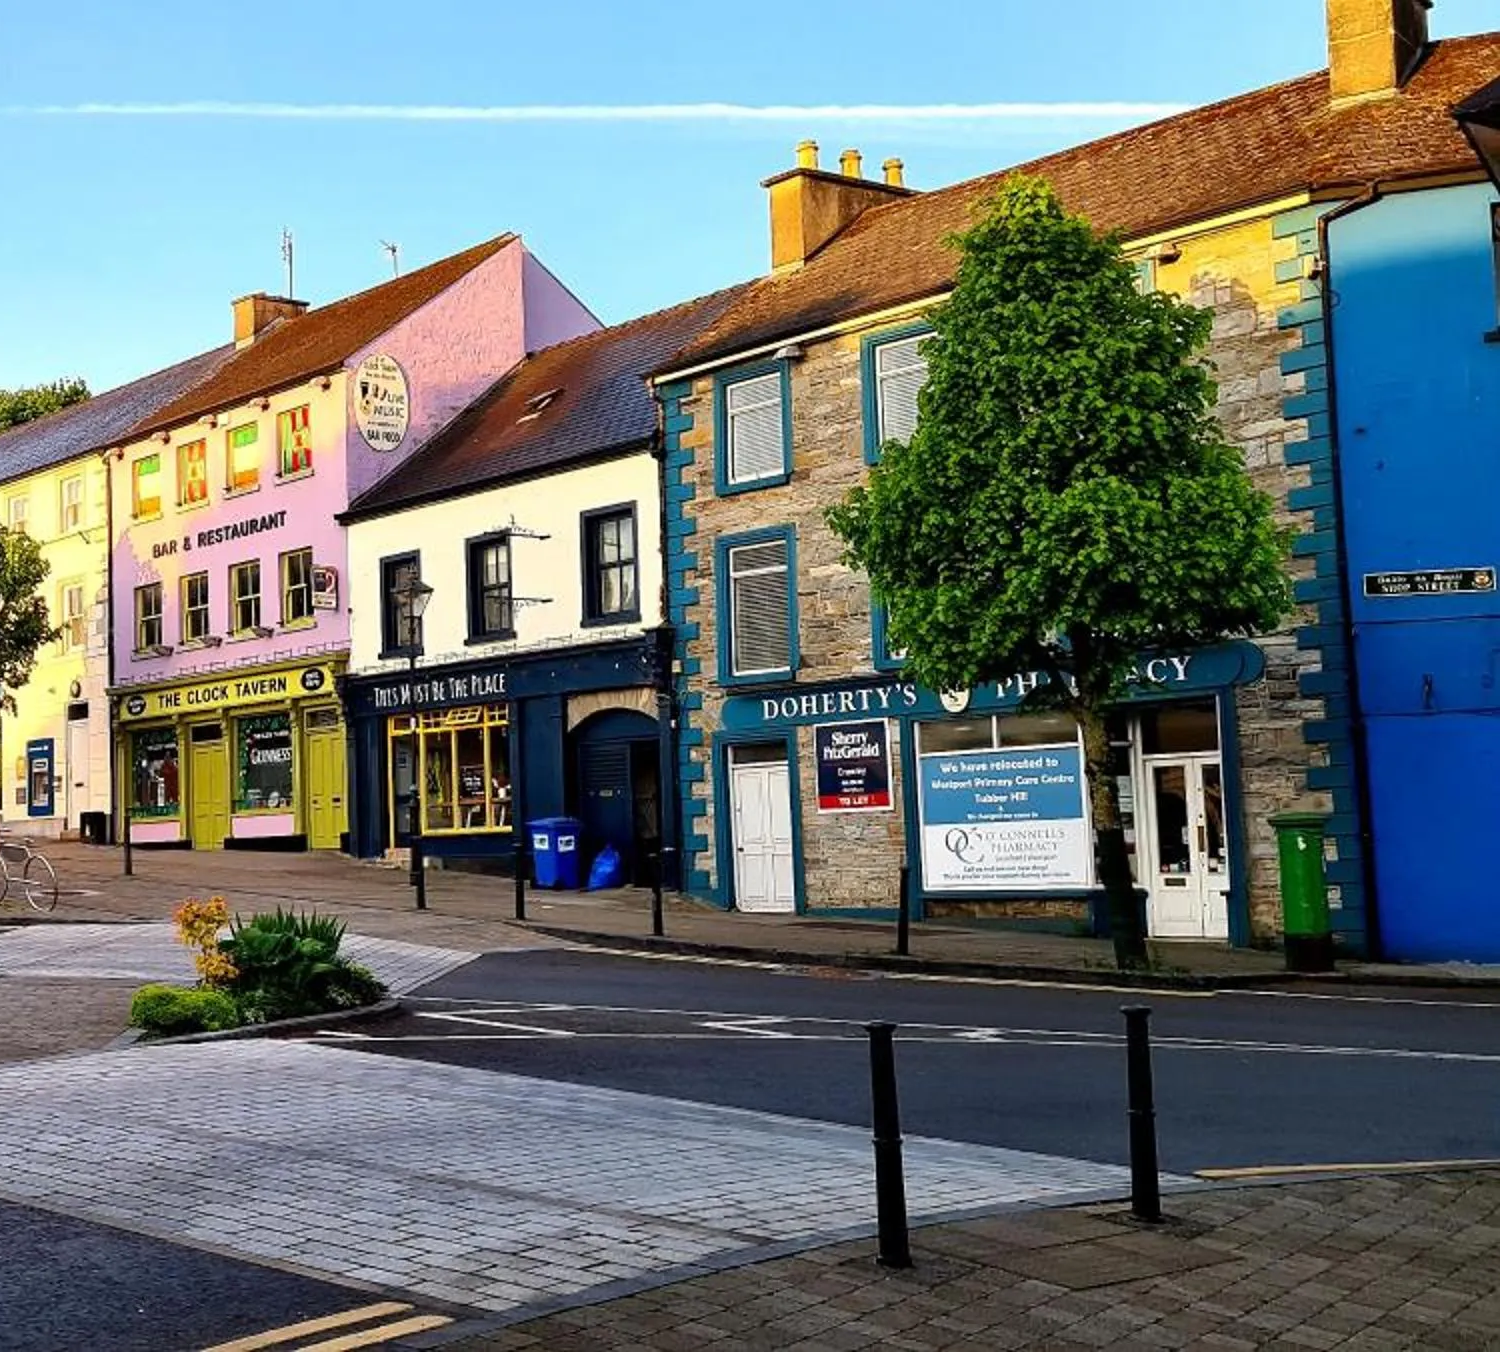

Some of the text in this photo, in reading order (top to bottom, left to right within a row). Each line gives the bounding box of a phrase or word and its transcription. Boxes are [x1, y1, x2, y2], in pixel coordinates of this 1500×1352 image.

[153, 510, 287, 558] BAR & RESTAURANT
[1417, 581, 1460, 591] STREET
[158, 691, 180, 709] THE
[187, 685, 229, 704] CLOCK
[234, 676, 288, 698] TAVERN
[374, 687, 399, 707] THIS
[431, 680, 446, 701] BE
[449, 677, 468, 698] THE
[471, 673, 506, 696] PLACE
[762, 655, 1191, 720] DOHERTY'S PHACY
[831, 731, 868, 747] Sherry
[250, 748, 292, 764] GUINNESS
[823, 743, 880, 760] FitzGerald
[940, 757, 1059, 773] We have relocated to
[931, 774, 1075, 790] Westport Primary Care Centre
